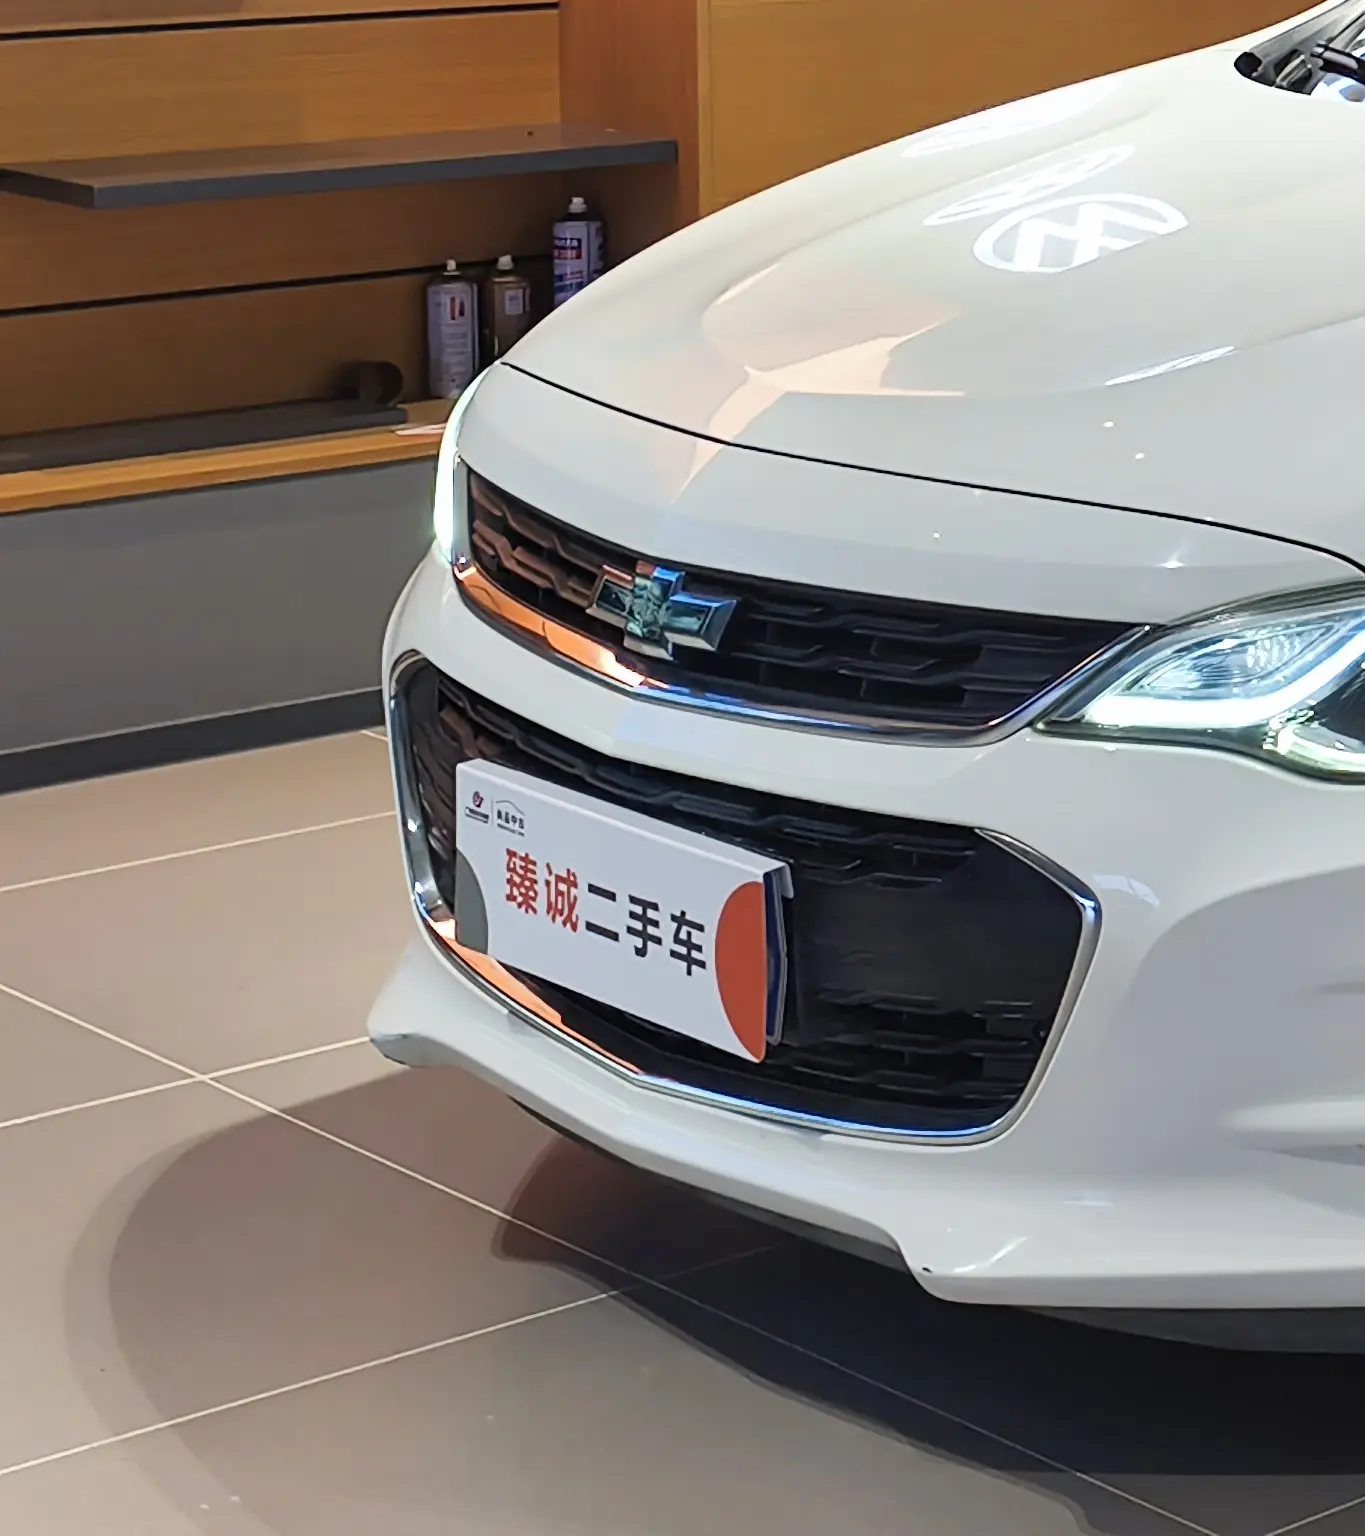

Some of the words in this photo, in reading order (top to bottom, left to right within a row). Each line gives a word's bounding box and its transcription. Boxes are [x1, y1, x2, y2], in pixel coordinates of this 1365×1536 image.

[504, 847, 708, 978] 臻诚二手车
